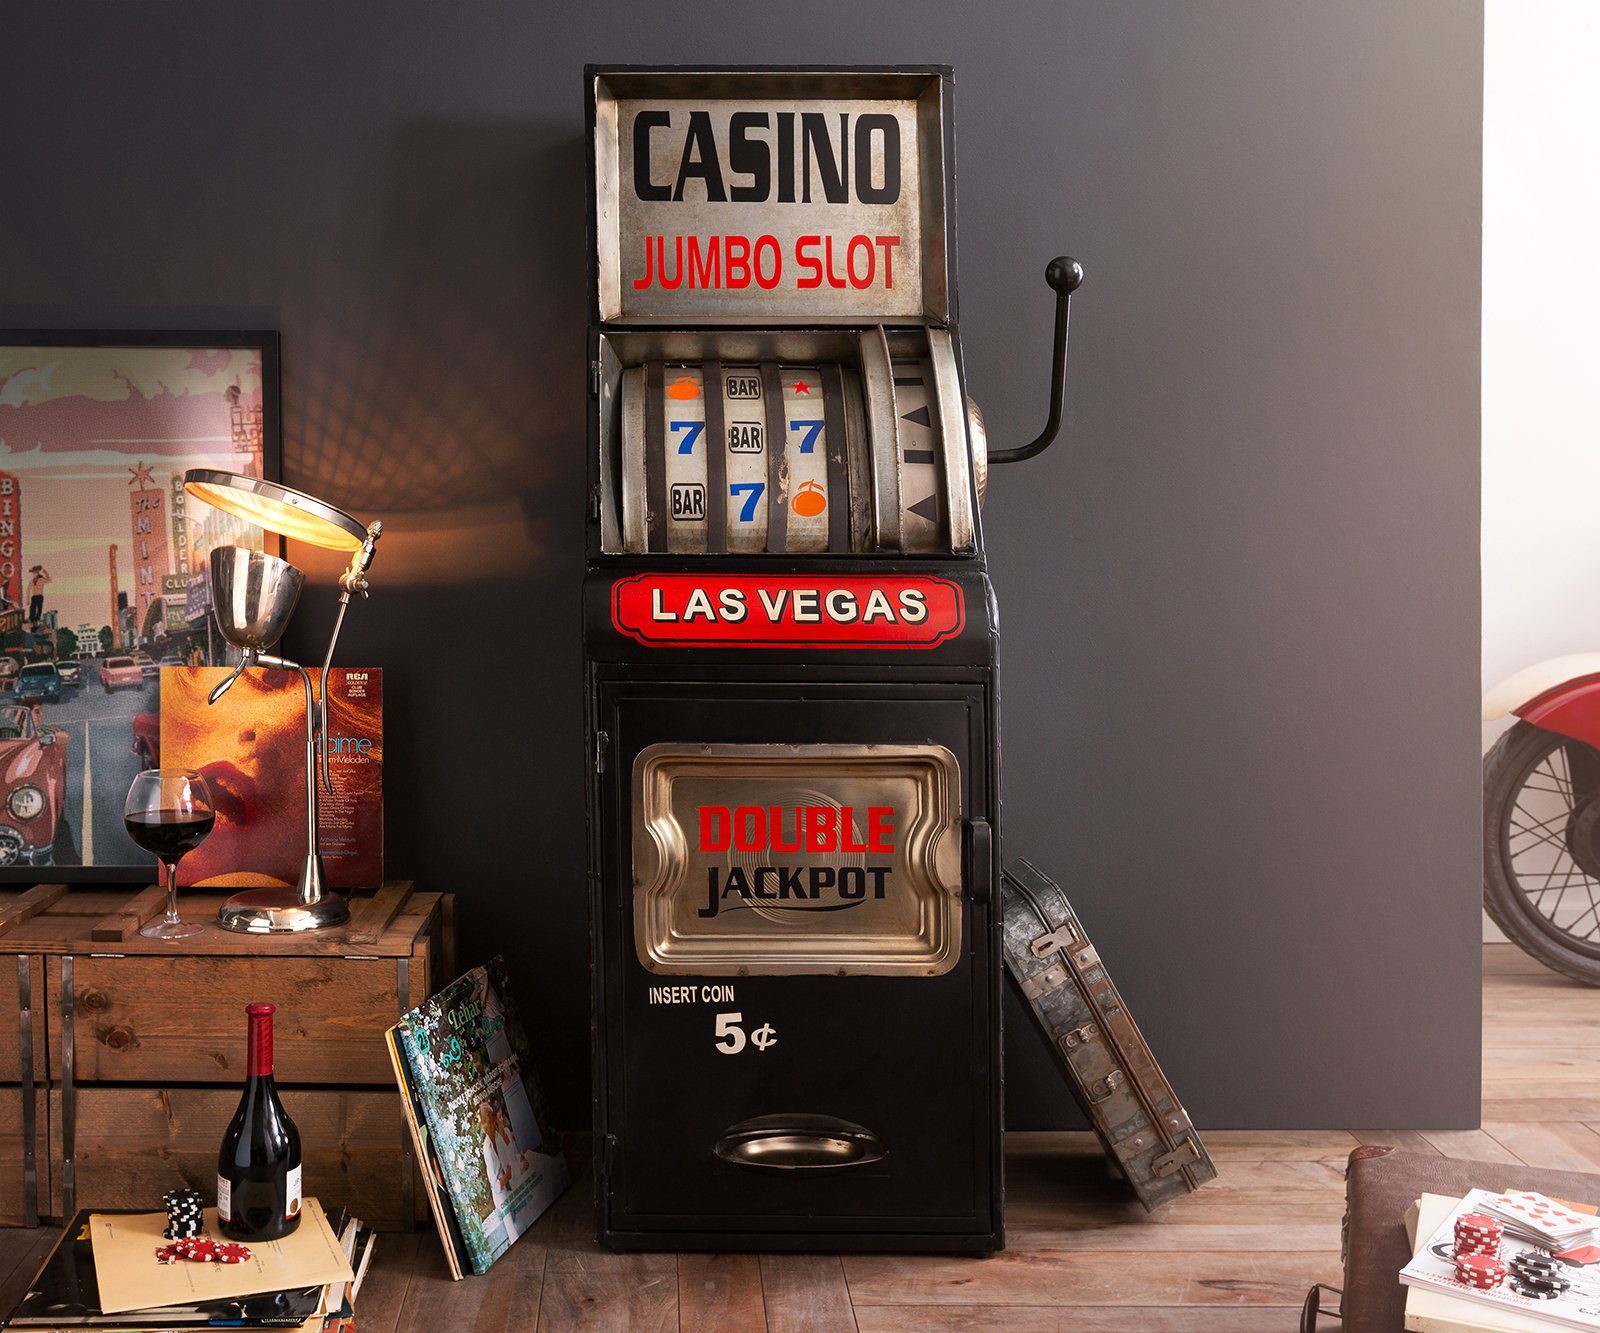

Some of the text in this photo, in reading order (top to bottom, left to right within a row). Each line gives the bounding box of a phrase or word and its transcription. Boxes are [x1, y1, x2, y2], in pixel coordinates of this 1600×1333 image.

[633, 111, 901, 205] CASINO
[634, 234, 900, 290] JUMBO SLOT
[728, 379, 758, 398] BAR
[670, 421, 705, 455] 7
[731, 426, 761, 449] BAR
[790, 420, 825, 454] 7
[673, 488, 703, 516] BAR
[730, 483, 765, 522] 7
[0, 479, 15, 579] BINGO
[652, 588, 928, 623] LAS VEGAS
[699, 806, 894, 853] DOUBLE
[698, 866, 892, 918] JACKPOT
[649, 985, 735, 1005] INSERT COIN
